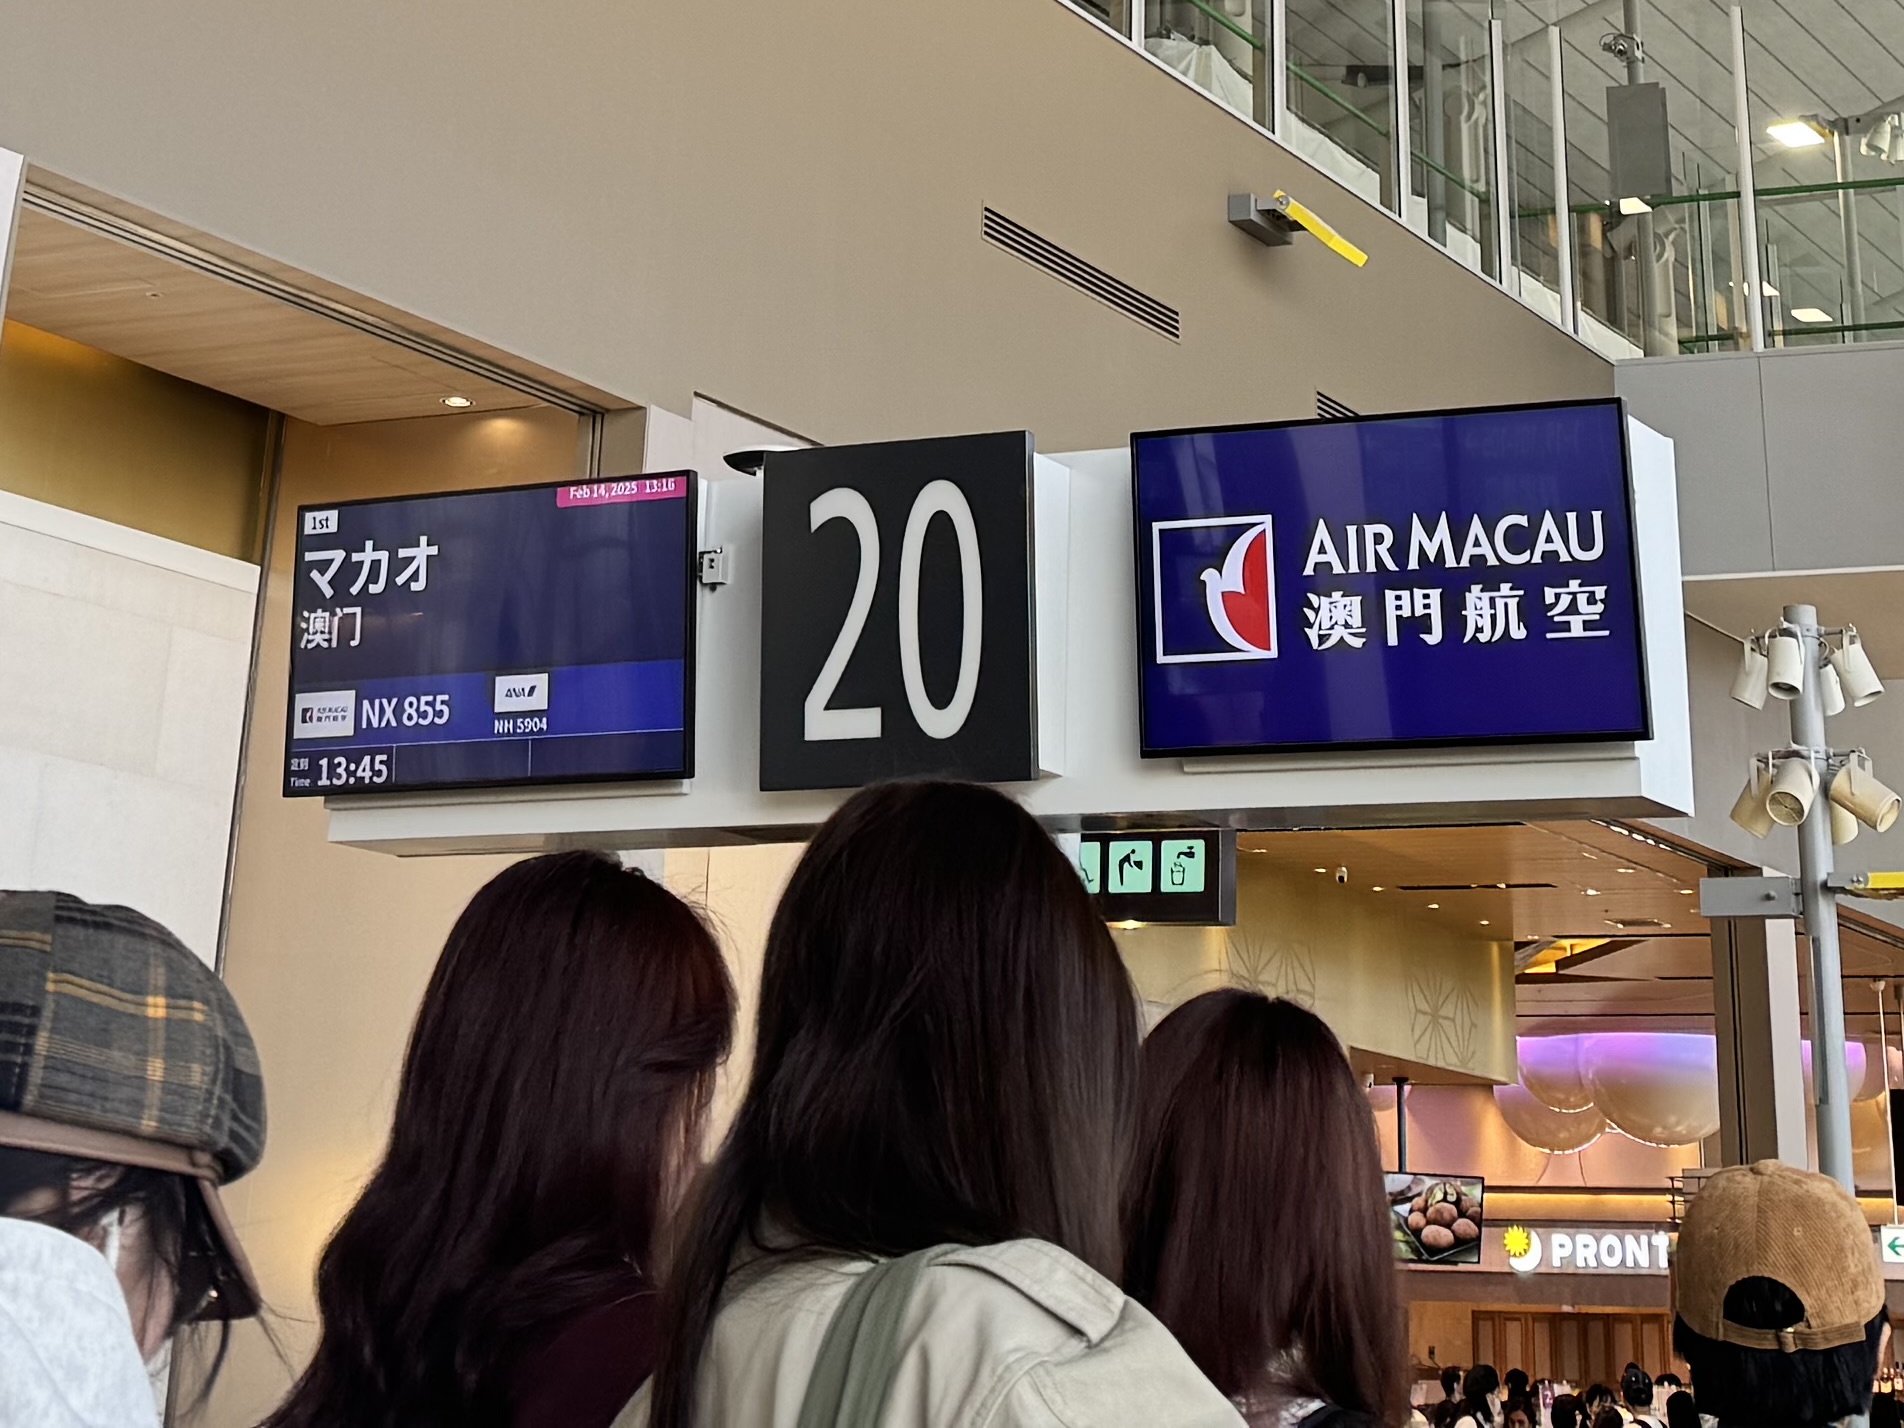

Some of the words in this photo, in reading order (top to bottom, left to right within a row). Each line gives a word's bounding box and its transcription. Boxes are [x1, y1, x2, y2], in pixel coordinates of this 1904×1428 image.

[570, 485, 590, 500] Feb
[311, 515, 331, 531] 1st
[1302, 517, 1400, 576] AIR
[1406, 509, 1604, 571] MACAU
[304, 535, 438, 599] マカオ
[299, 606, 363, 650] 澳门
[804, 479, 983, 741] 20
[1302, 579, 1611, 651] 澳門航空
[361, 697, 398, 729] NX
[402, 694, 450, 727] 855
[494, 718, 513, 734] NH
[516, 717, 547, 733] 5904
[317, 754, 388, 787] 13:45
